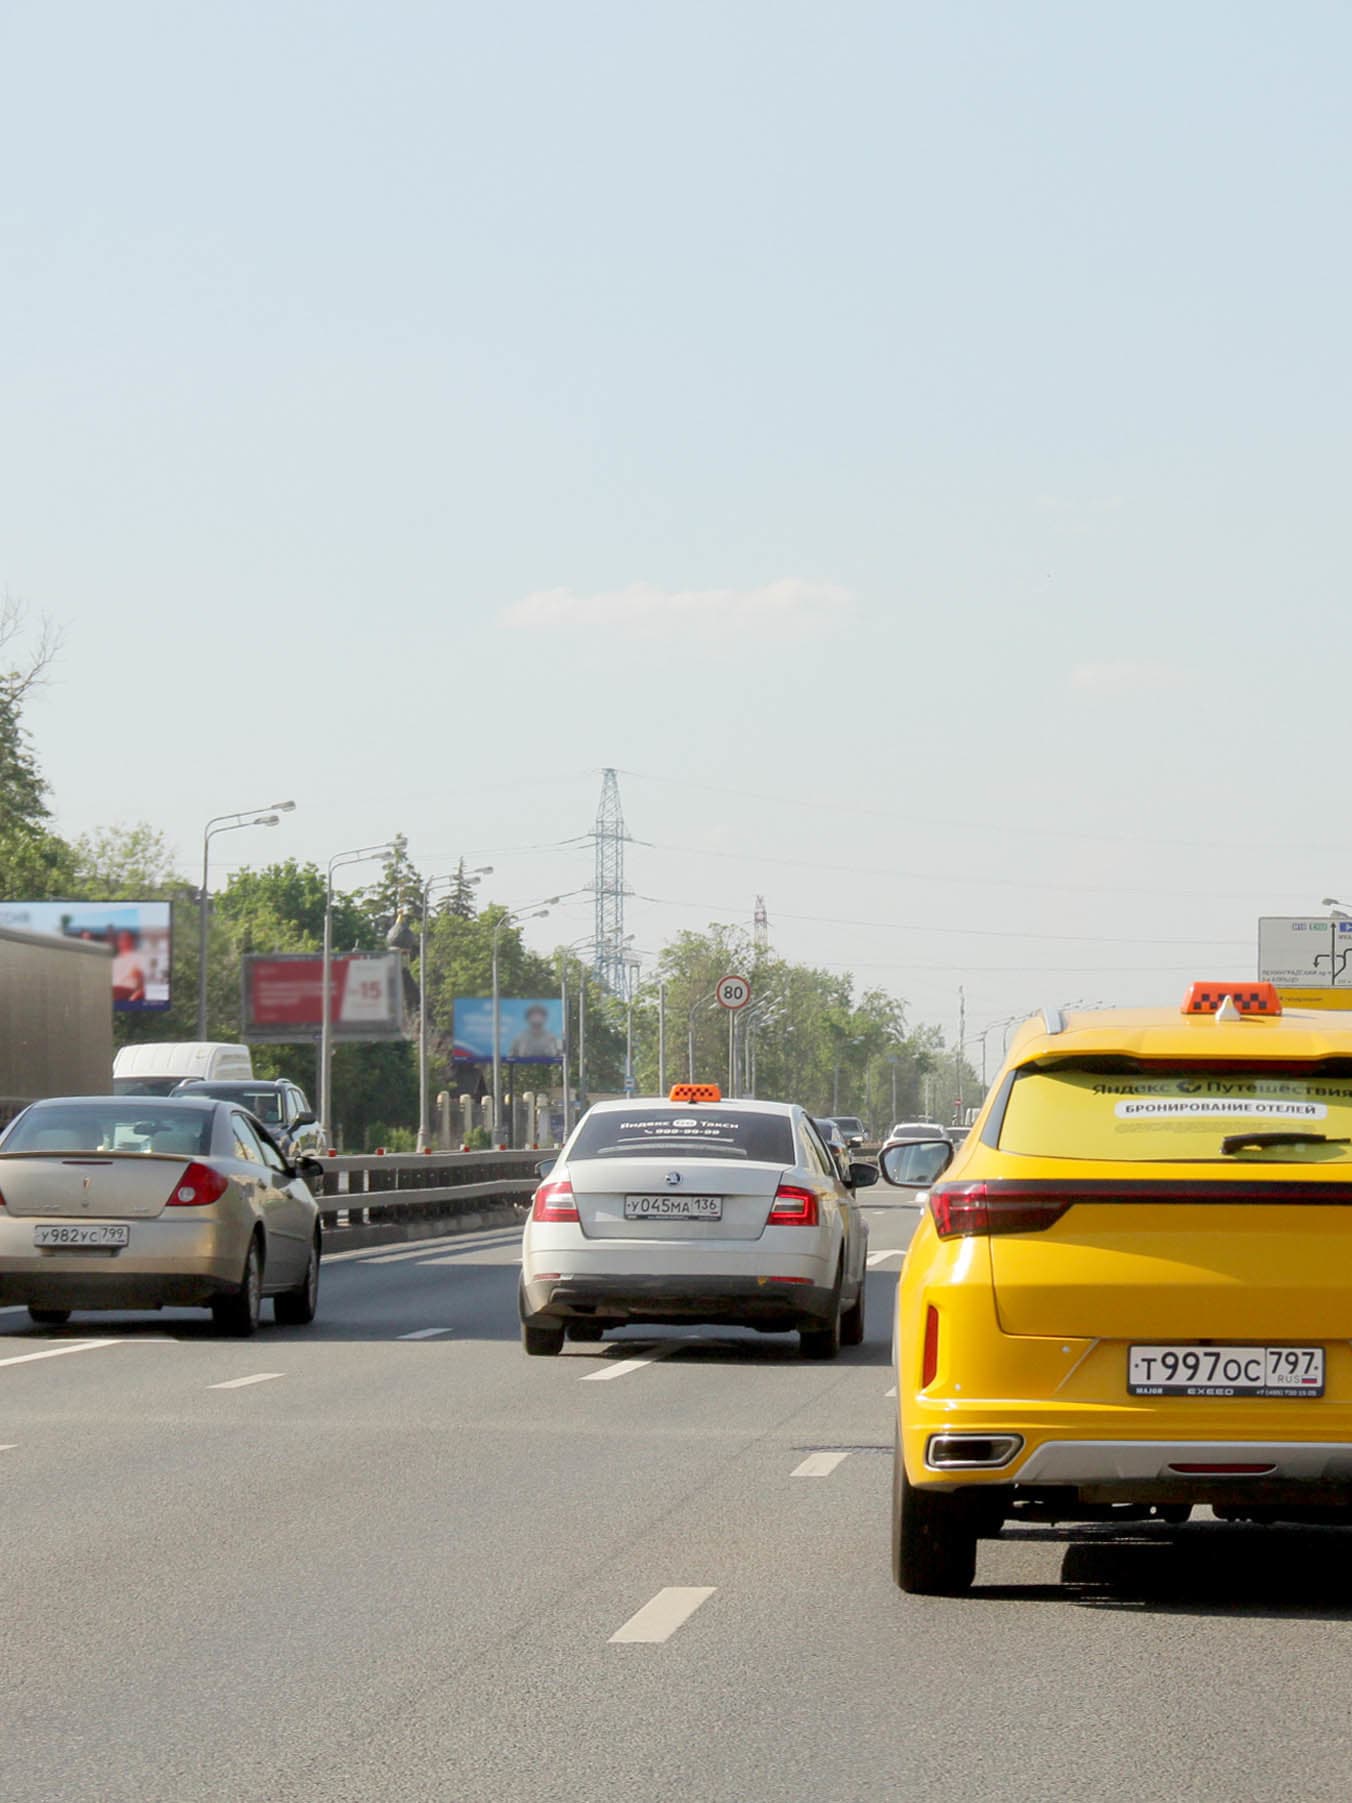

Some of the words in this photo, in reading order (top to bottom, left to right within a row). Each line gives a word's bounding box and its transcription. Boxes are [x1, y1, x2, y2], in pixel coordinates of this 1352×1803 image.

[724, 986, 743, 999] 80
[1093, 1082, 1169, 1096] Яндекс
[1125, 1102, 1251, 1114] БРОНИРОВАНИЕ
[1255, 1103, 1317, 1115] ОТЕЛЕЙ
[1277, 1375, 1300, 1384] RUS
[1135, 1387, 1163, 1395] MAJOR
[1187, 1388, 1235, 1396] EXEED
